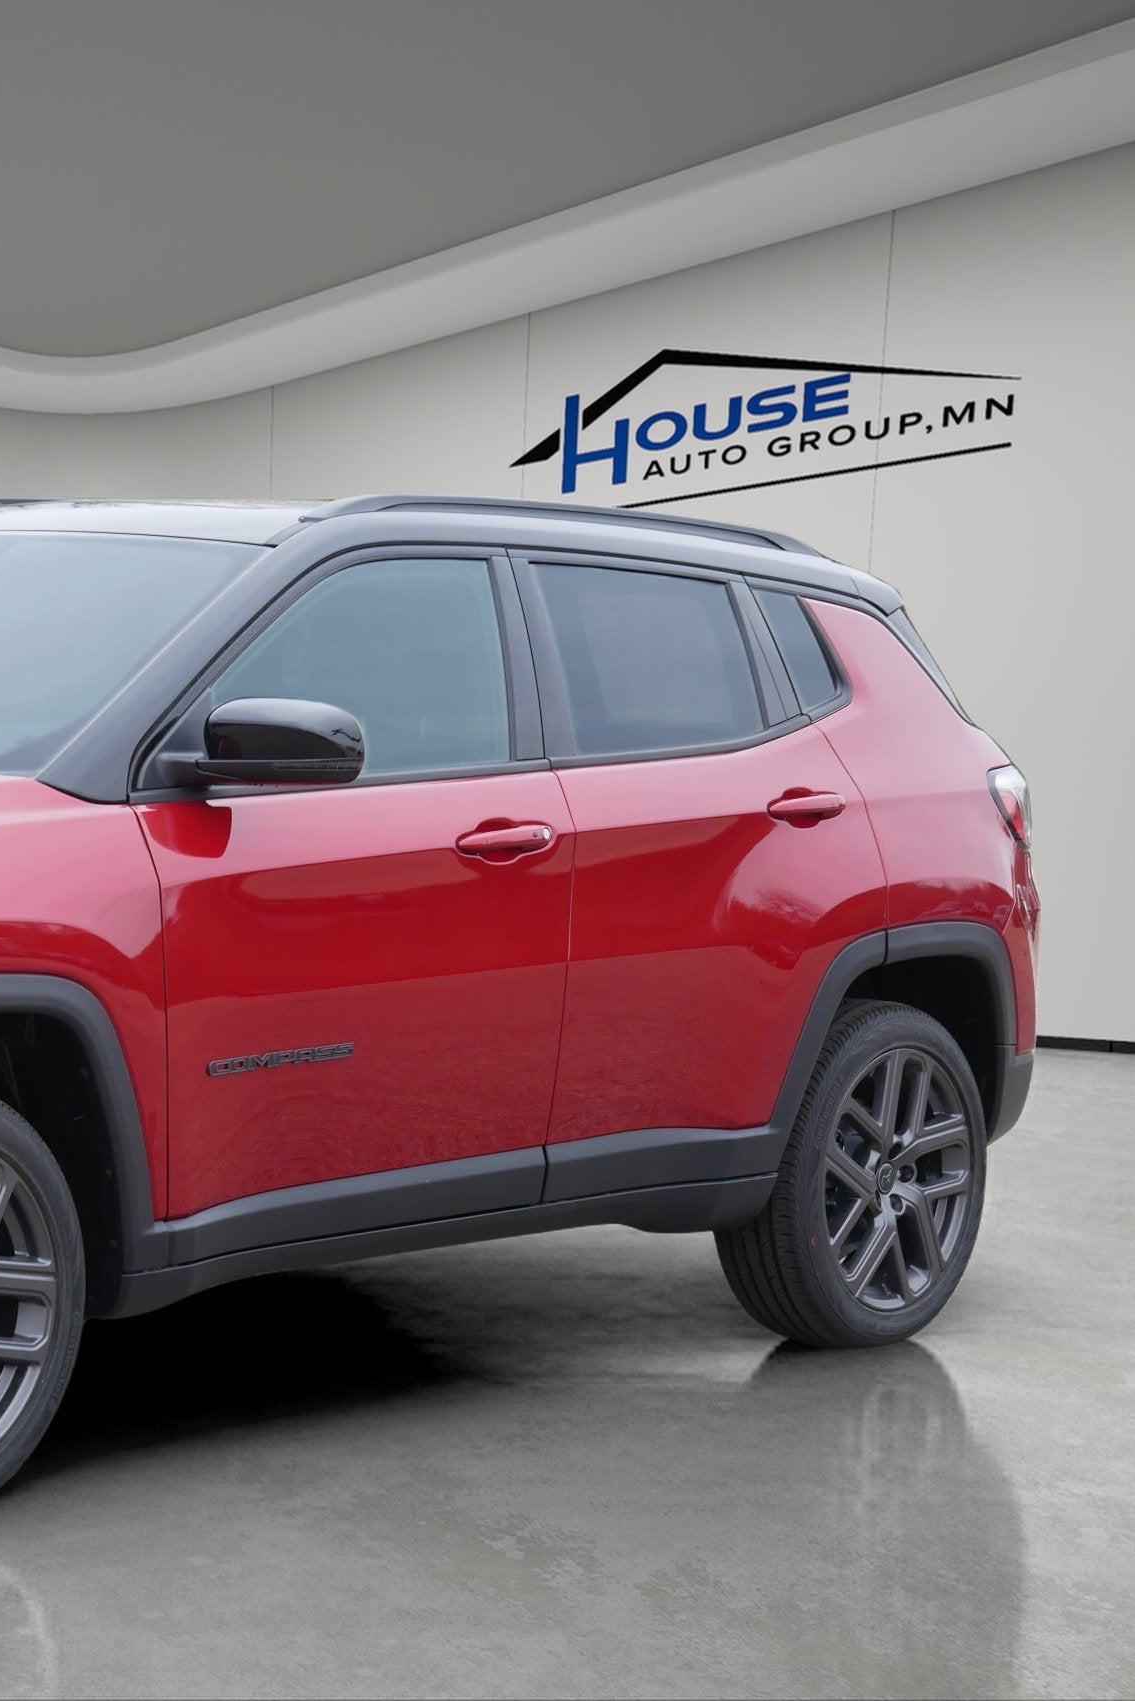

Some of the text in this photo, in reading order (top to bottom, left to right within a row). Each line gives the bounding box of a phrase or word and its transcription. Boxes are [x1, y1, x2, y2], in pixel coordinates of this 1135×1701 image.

[561, 373, 851, 494] HOUSE
[642, 444, 747, 480] AUTO
[206, 1042, 354, 1076] COMPASS
